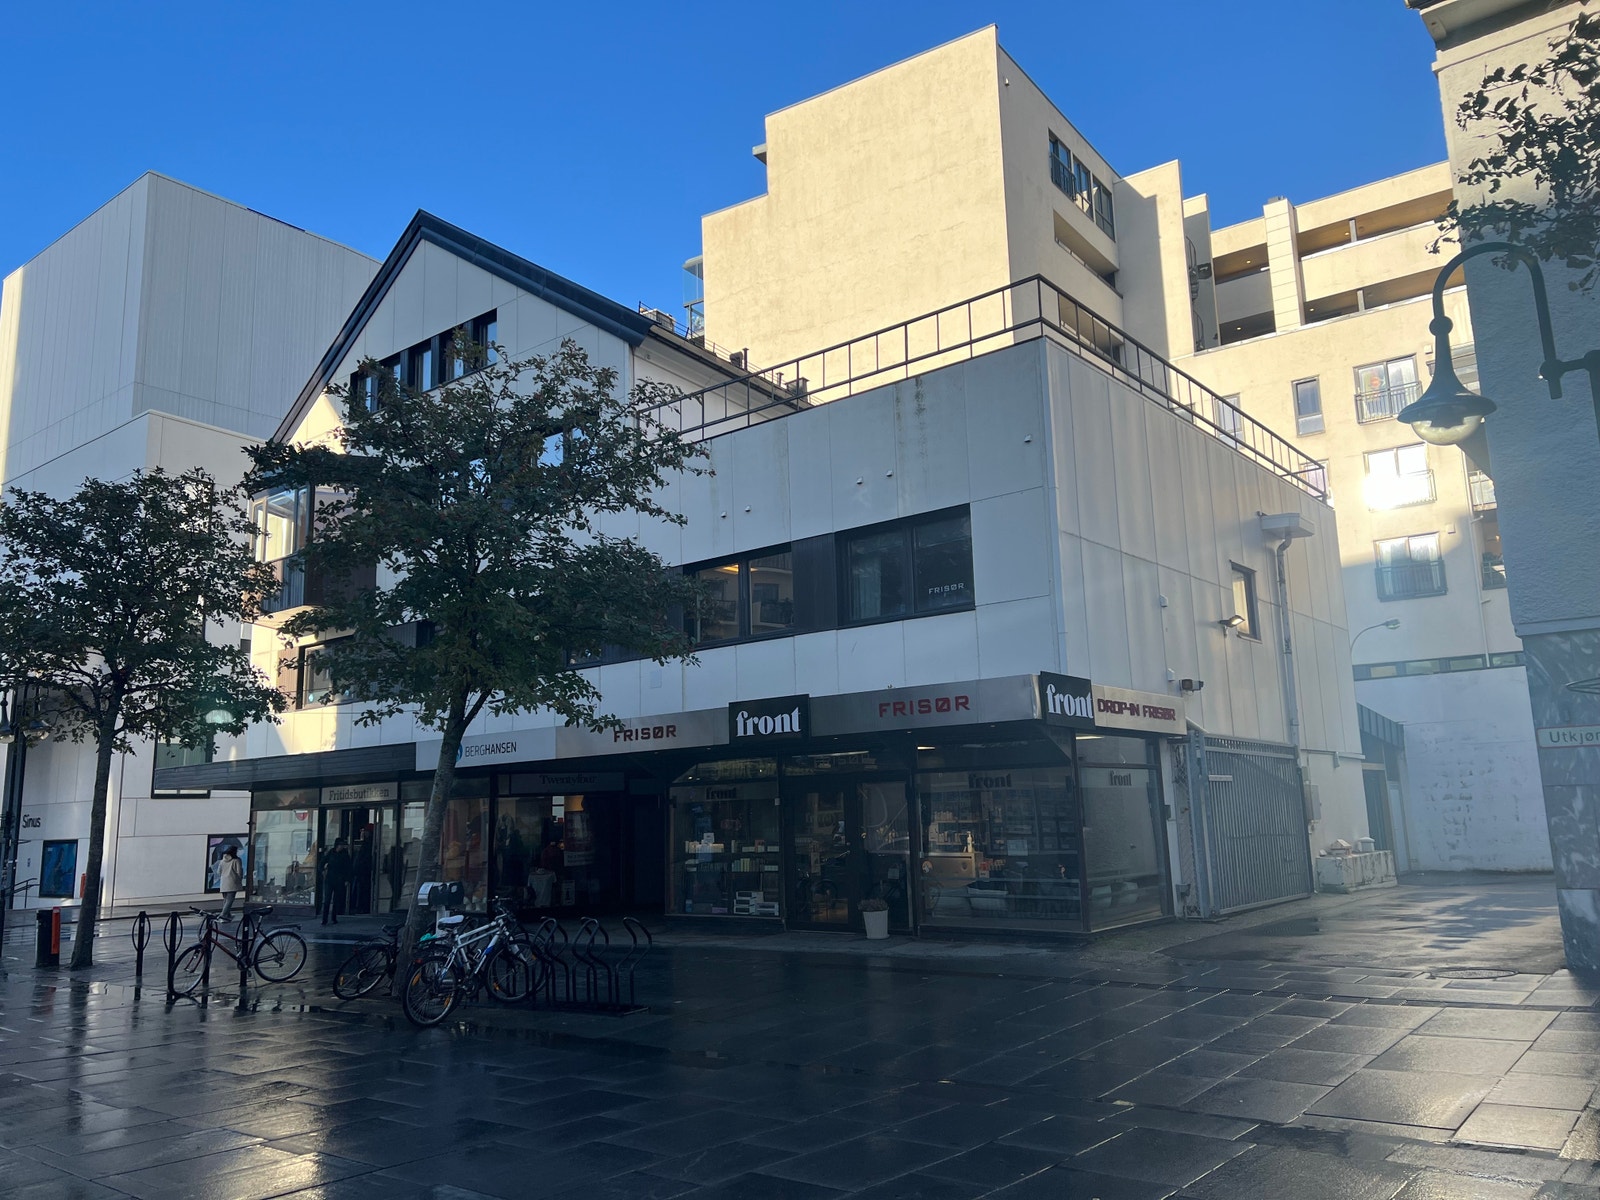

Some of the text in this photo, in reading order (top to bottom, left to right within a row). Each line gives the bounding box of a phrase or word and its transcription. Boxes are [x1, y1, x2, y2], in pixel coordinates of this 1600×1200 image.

[879, 695, 970, 718] FRISØR
[1045, 684, 1094, 719] front
[1097, 698, 1176, 721] DROP-IN FRISØR
[735, 706, 801, 737] front
[613, 724, 677, 743] FRISØR
[464, 741, 517, 757] BERGHANSEN
[968, 773, 1011, 788] front
[1109, 770, 1132, 786] front
[23, 814, 41, 828] Sinus
